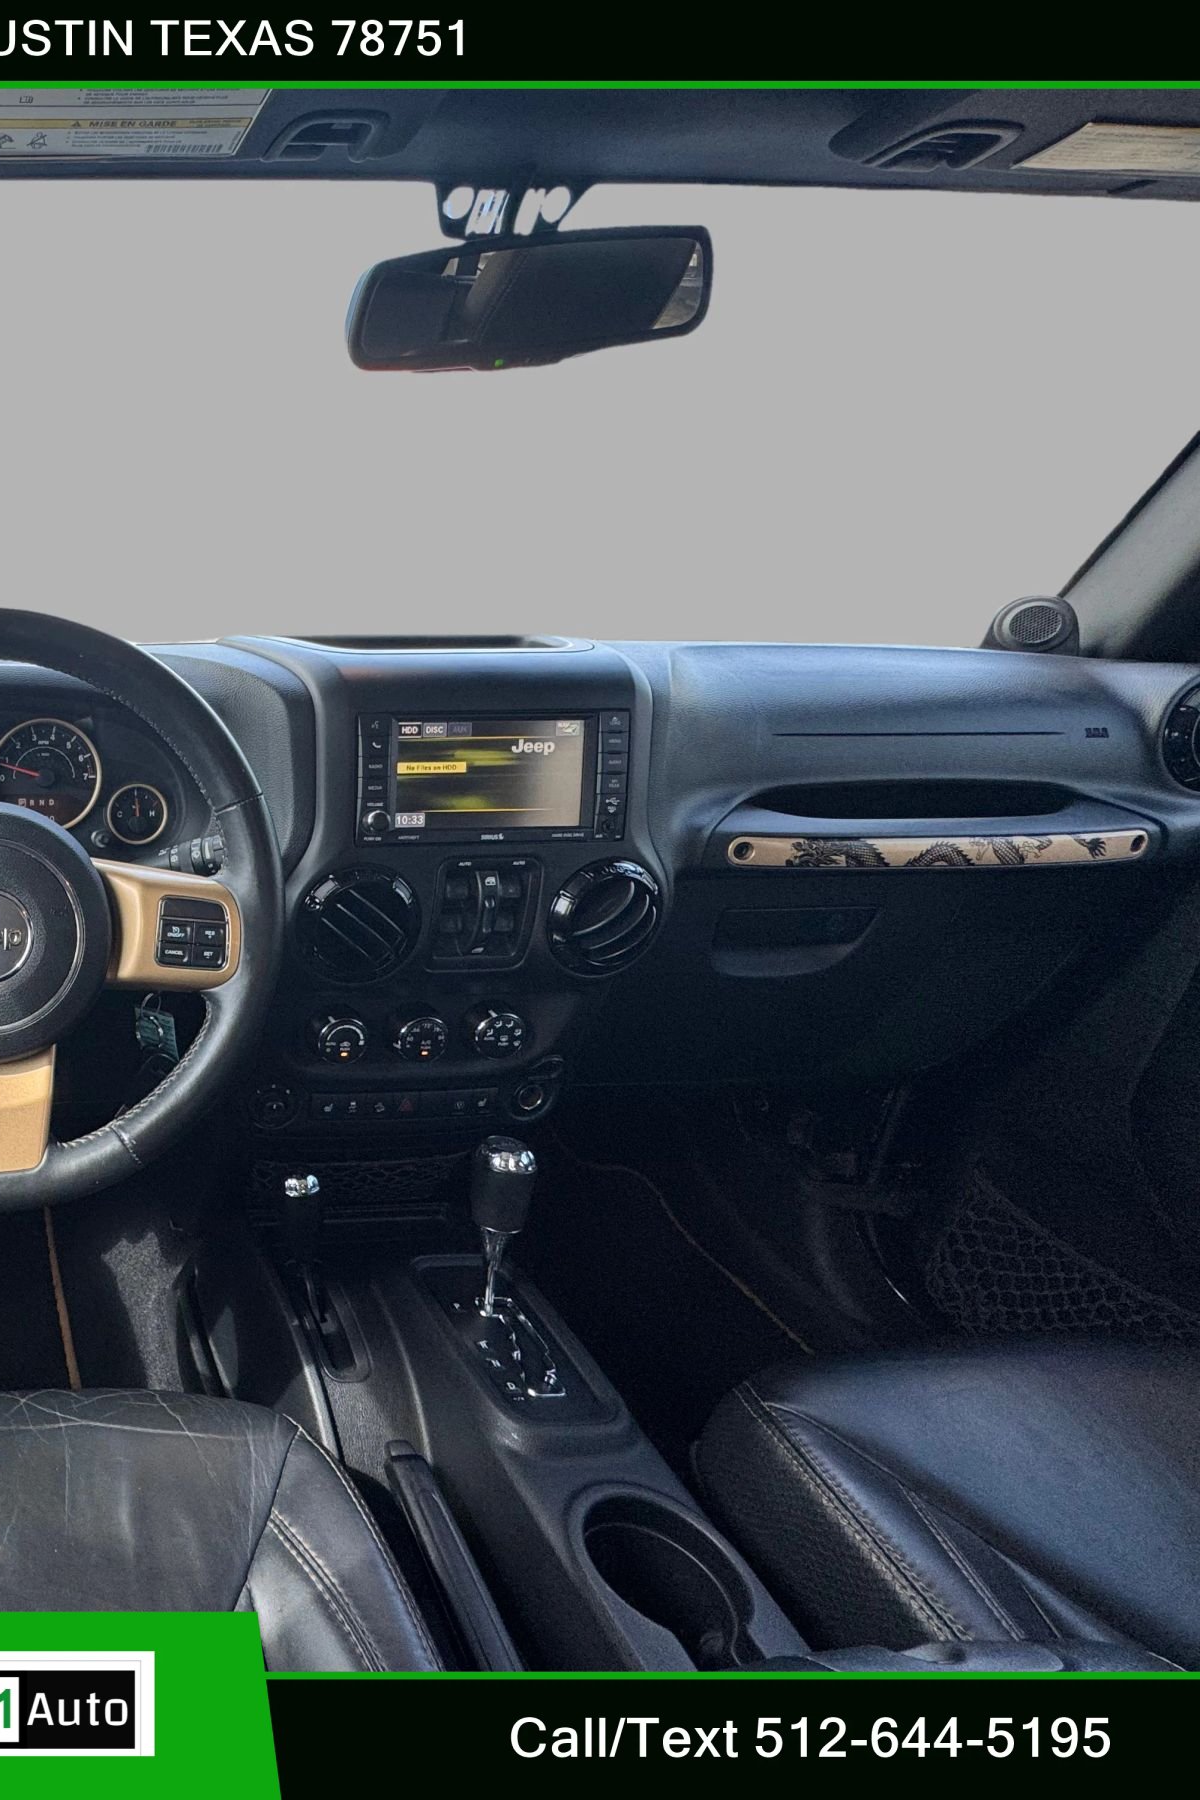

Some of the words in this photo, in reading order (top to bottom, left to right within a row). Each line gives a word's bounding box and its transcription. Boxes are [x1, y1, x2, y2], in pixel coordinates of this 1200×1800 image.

[401, 726, 419, 734] HDD
[425, 726, 444, 734] DISC
[511, 739, 555, 756] Jeep
[396, 815, 424, 825] 10:33
